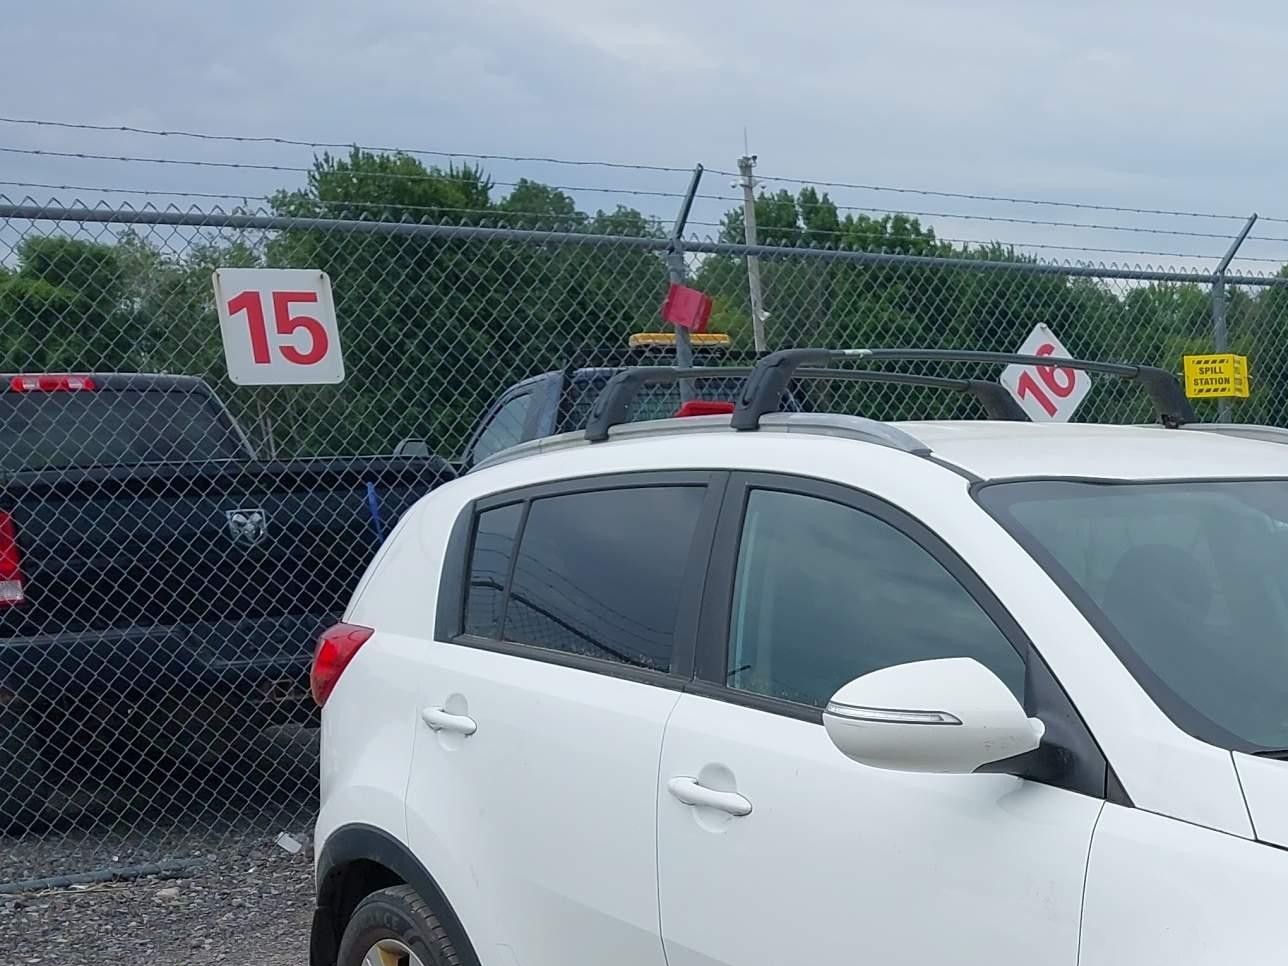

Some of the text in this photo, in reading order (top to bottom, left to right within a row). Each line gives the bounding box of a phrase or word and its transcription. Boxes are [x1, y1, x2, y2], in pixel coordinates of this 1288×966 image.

[227, 291, 329, 365] 15
[1017, 343, 1076, 417] 16
[1193, 376, 1231, 386] STATION
[1198, 366, 1224, 375] SPILL
